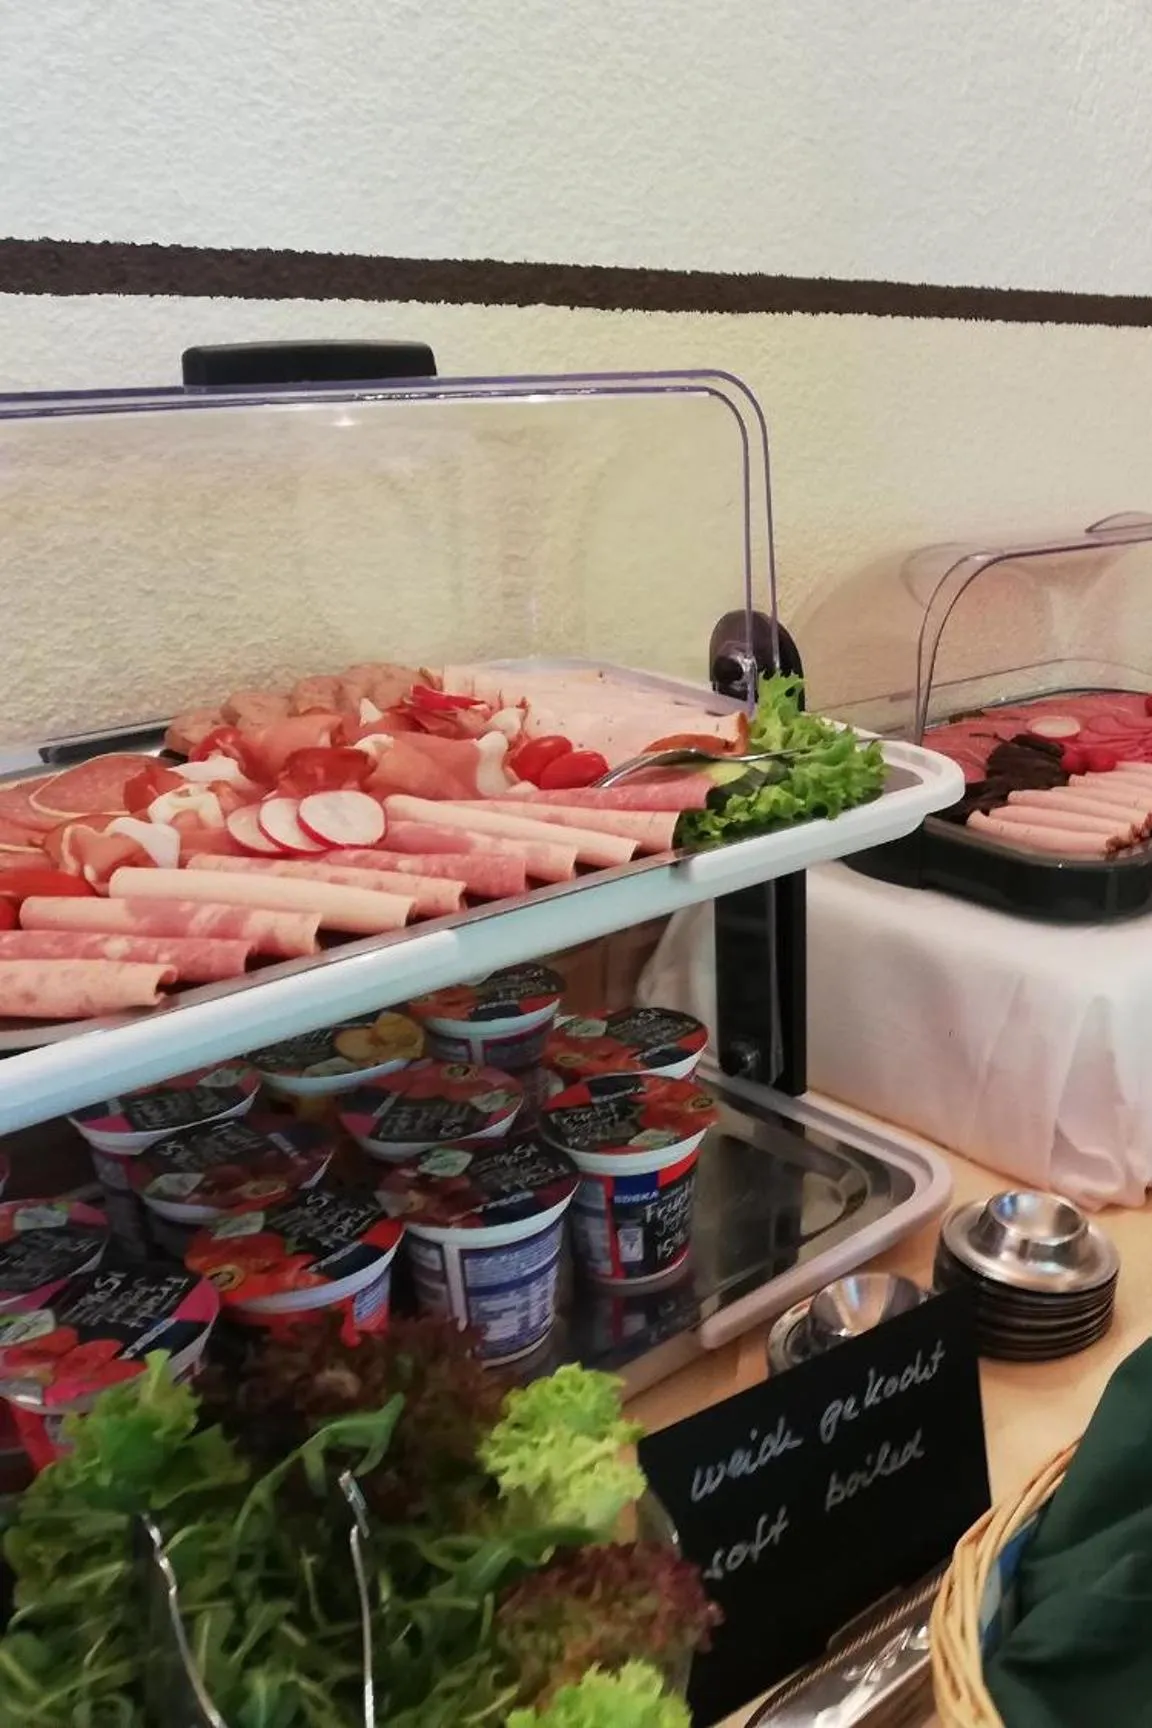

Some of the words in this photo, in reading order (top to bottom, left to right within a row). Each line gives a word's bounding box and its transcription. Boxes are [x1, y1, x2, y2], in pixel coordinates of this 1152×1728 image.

[690, 1416, 804, 1503] weich
[818, 1339, 947, 1445] gekocht
[703, 1504, 790, 1581] soft
[824, 1427, 927, 1512] boiled
